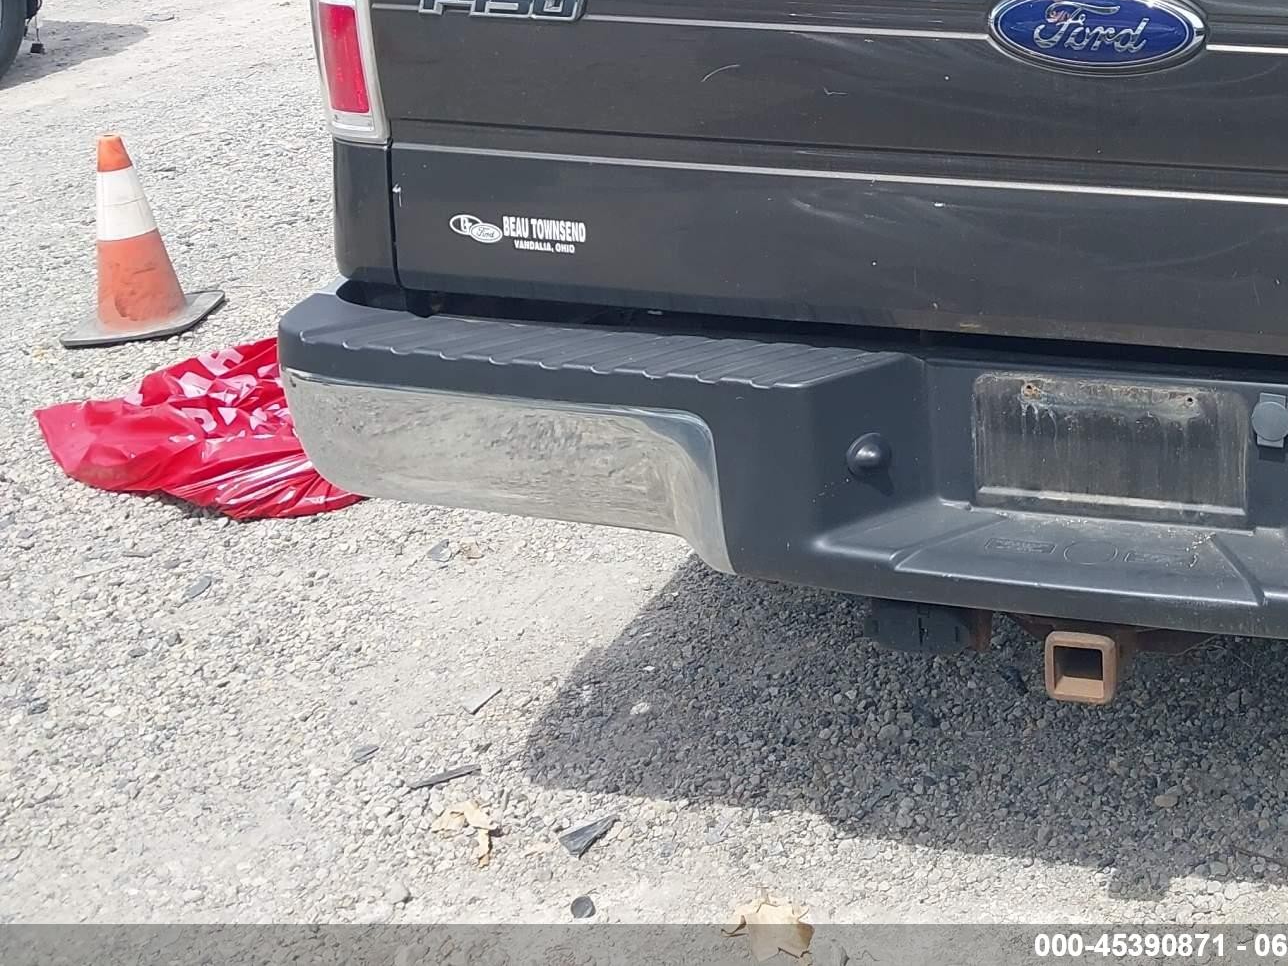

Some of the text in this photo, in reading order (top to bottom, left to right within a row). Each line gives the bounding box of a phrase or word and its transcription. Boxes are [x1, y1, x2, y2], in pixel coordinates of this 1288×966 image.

[1033, 0, 1150, 54] Ford
[502, 215, 586, 243] BEAU TOWNSEND
[513, 239, 575, 254] VANDALIA, OHIO
